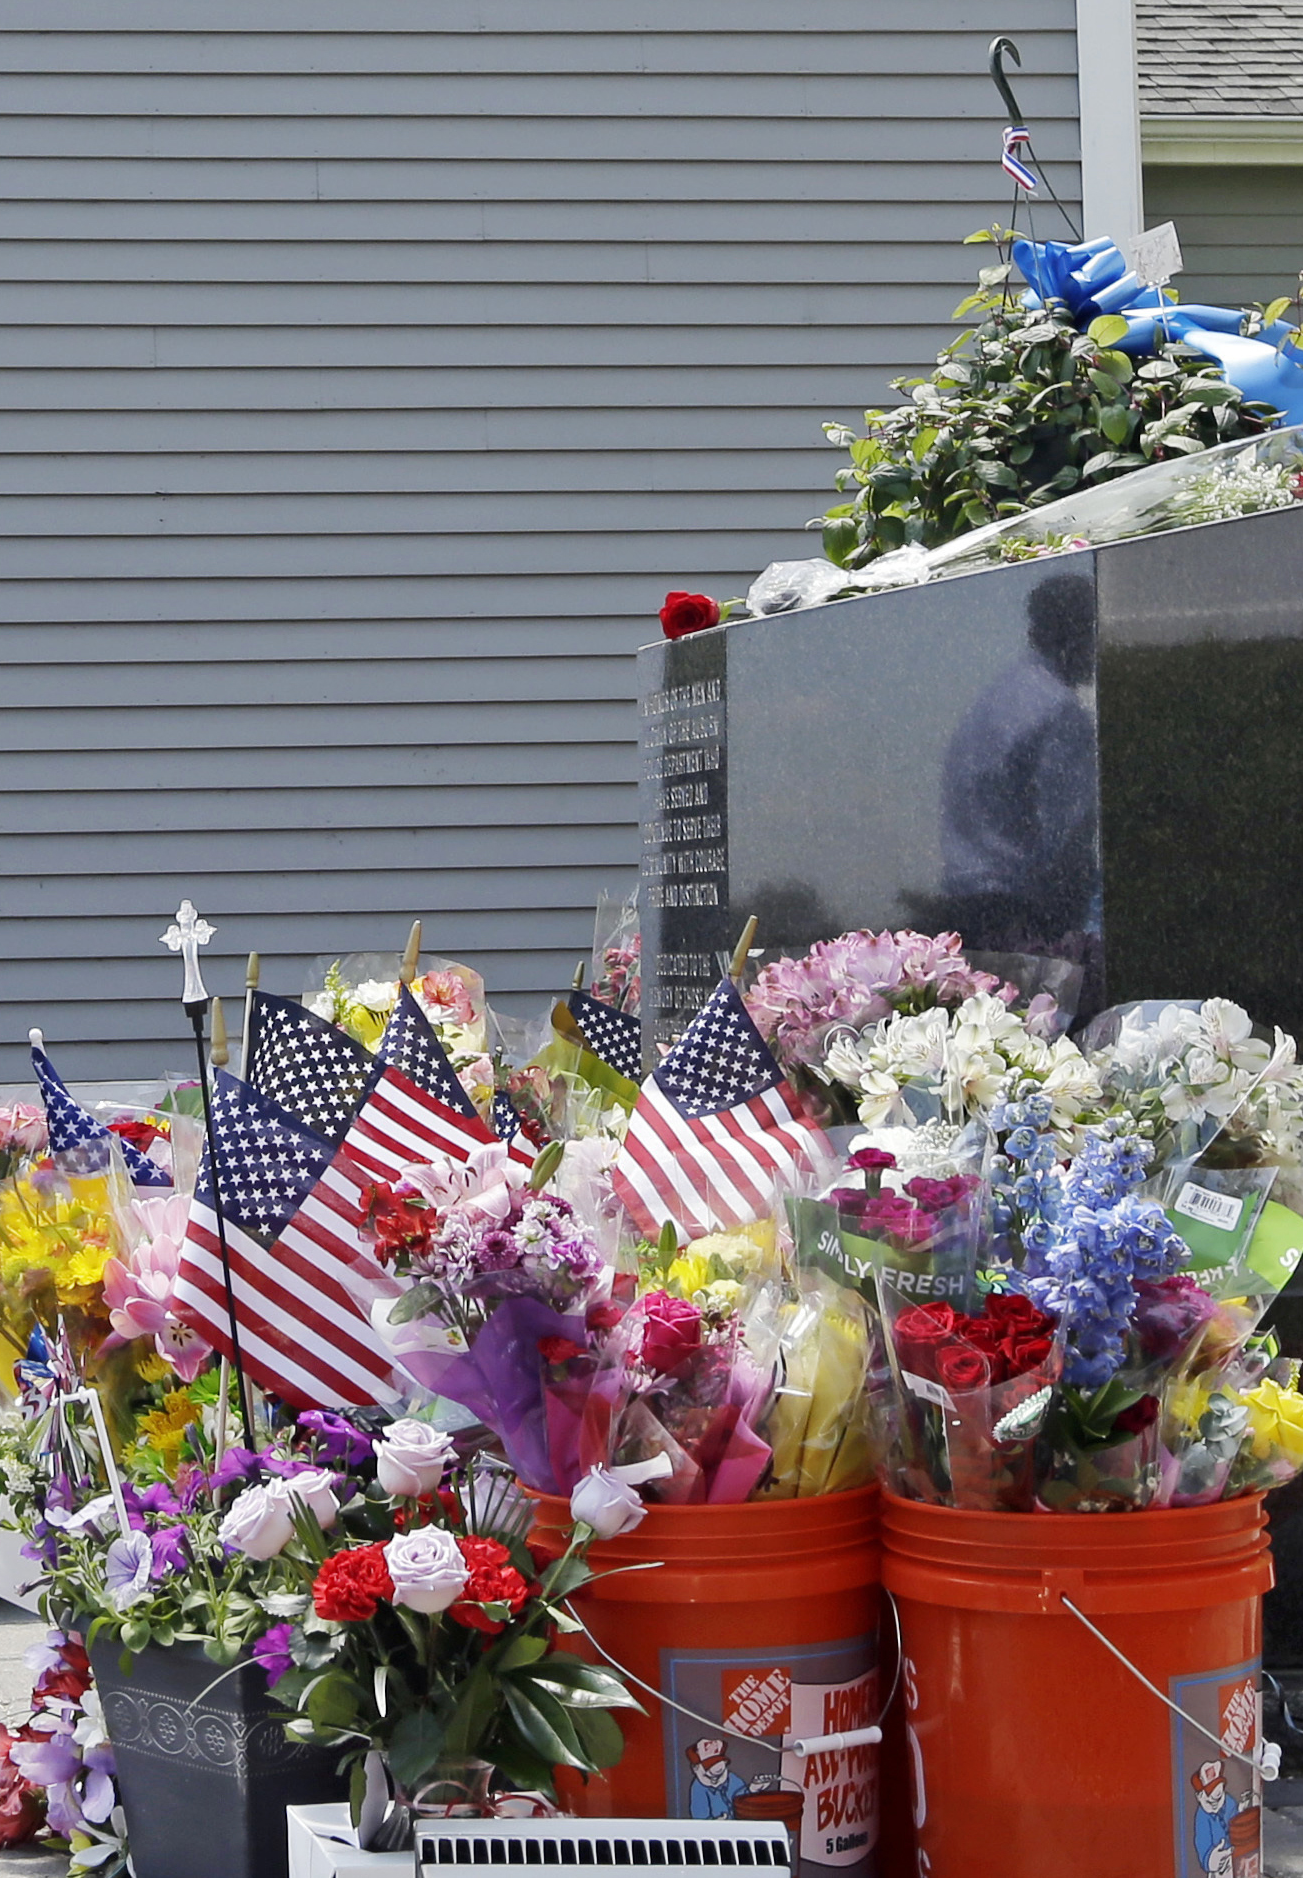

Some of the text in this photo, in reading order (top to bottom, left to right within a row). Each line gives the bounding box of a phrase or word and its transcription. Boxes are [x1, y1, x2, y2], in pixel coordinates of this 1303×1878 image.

[817, 1230, 964, 1296] SIMLY FRESH
[723, 1668, 791, 1735] HOME
[729, 1674, 760, 1703] THE
[748, 1691, 792, 1737] DEPOT
[826, 1838, 834, 1855] 5
